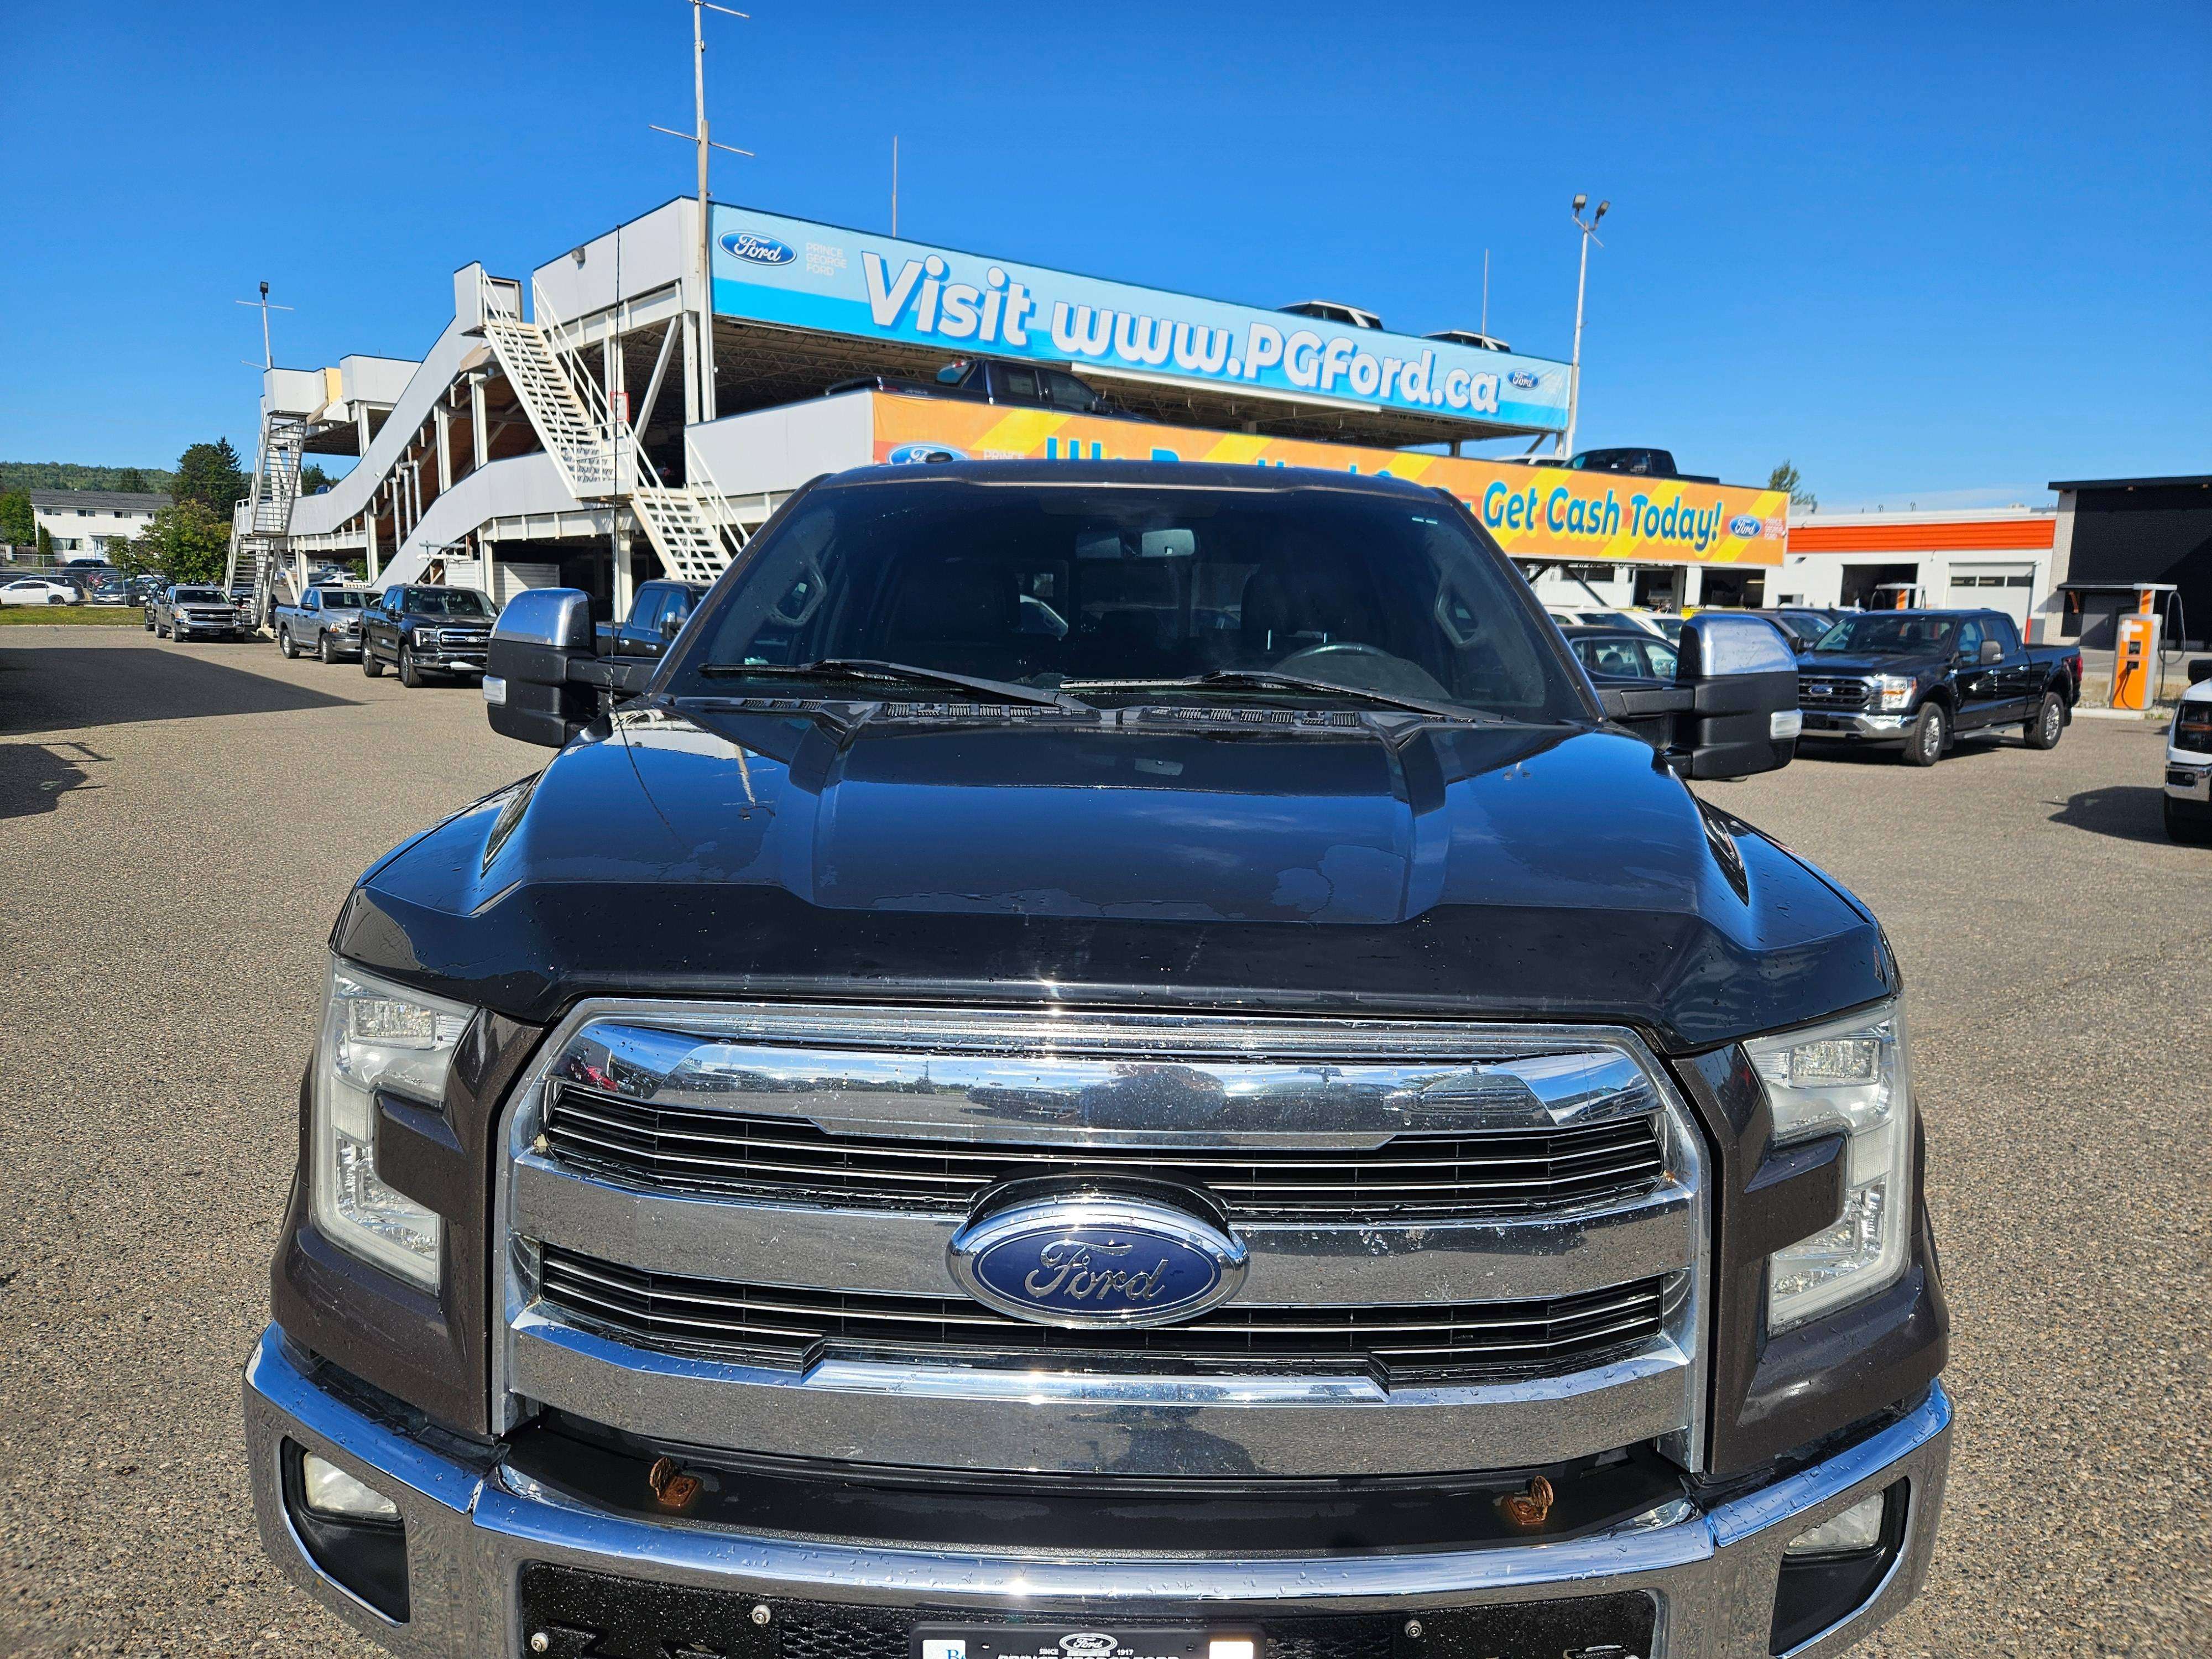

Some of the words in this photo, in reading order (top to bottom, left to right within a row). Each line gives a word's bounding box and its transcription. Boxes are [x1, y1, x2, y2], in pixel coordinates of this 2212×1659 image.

[734, 234, 782, 262] Ford
[805, 242, 843, 258] PRINCE
[805, 253, 848, 269] GEORGE
[806, 263, 835, 276] FORD
[862, 251, 1031, 347] Visit
[1483, 481, 1538, 531] Get
[1547, 486, 1620, 536] Cash
[1630, 493, 1722, 552] Today!
[1024, 1239, 1170, 1301] Ford
[1073, 1637, 1103, 1648] Ford
